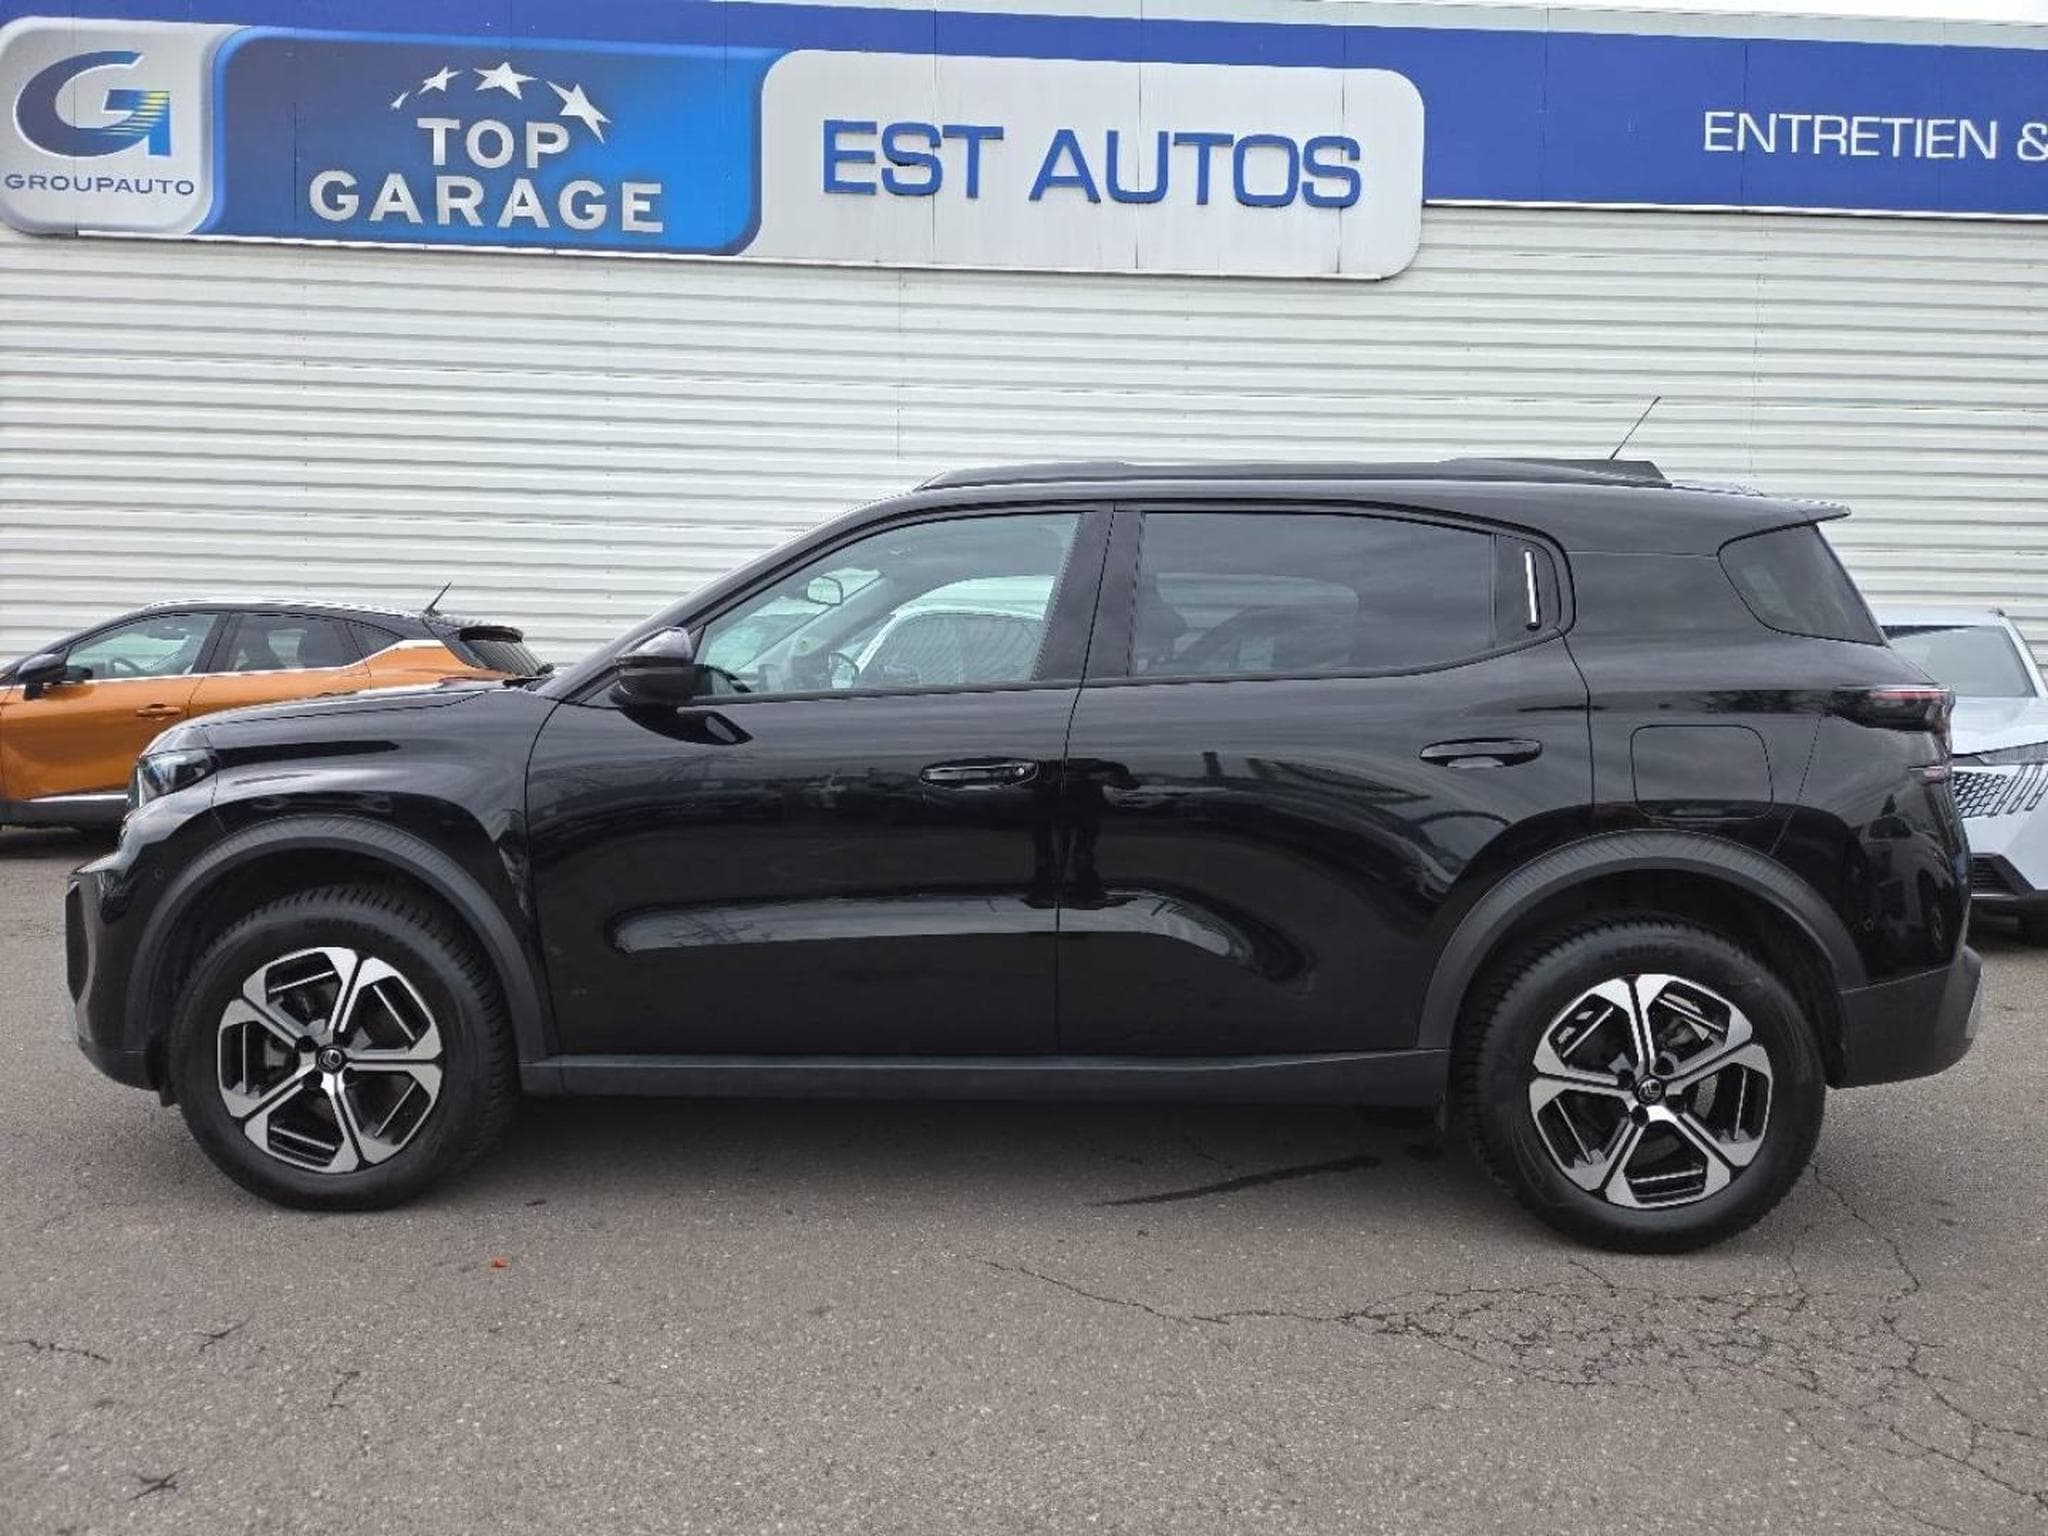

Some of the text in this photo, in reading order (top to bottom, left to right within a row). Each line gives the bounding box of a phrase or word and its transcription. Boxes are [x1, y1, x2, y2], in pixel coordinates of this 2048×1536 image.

[417, 117, 570, 169] TOP
[1704, 111, 2048, 162] ENTRETIEN &
[4, 174, 196, 196] GROUPAUTO
[822, 119, 1362, 209] EST AUTOS
[309, 170, 663, 233] GARAGE
